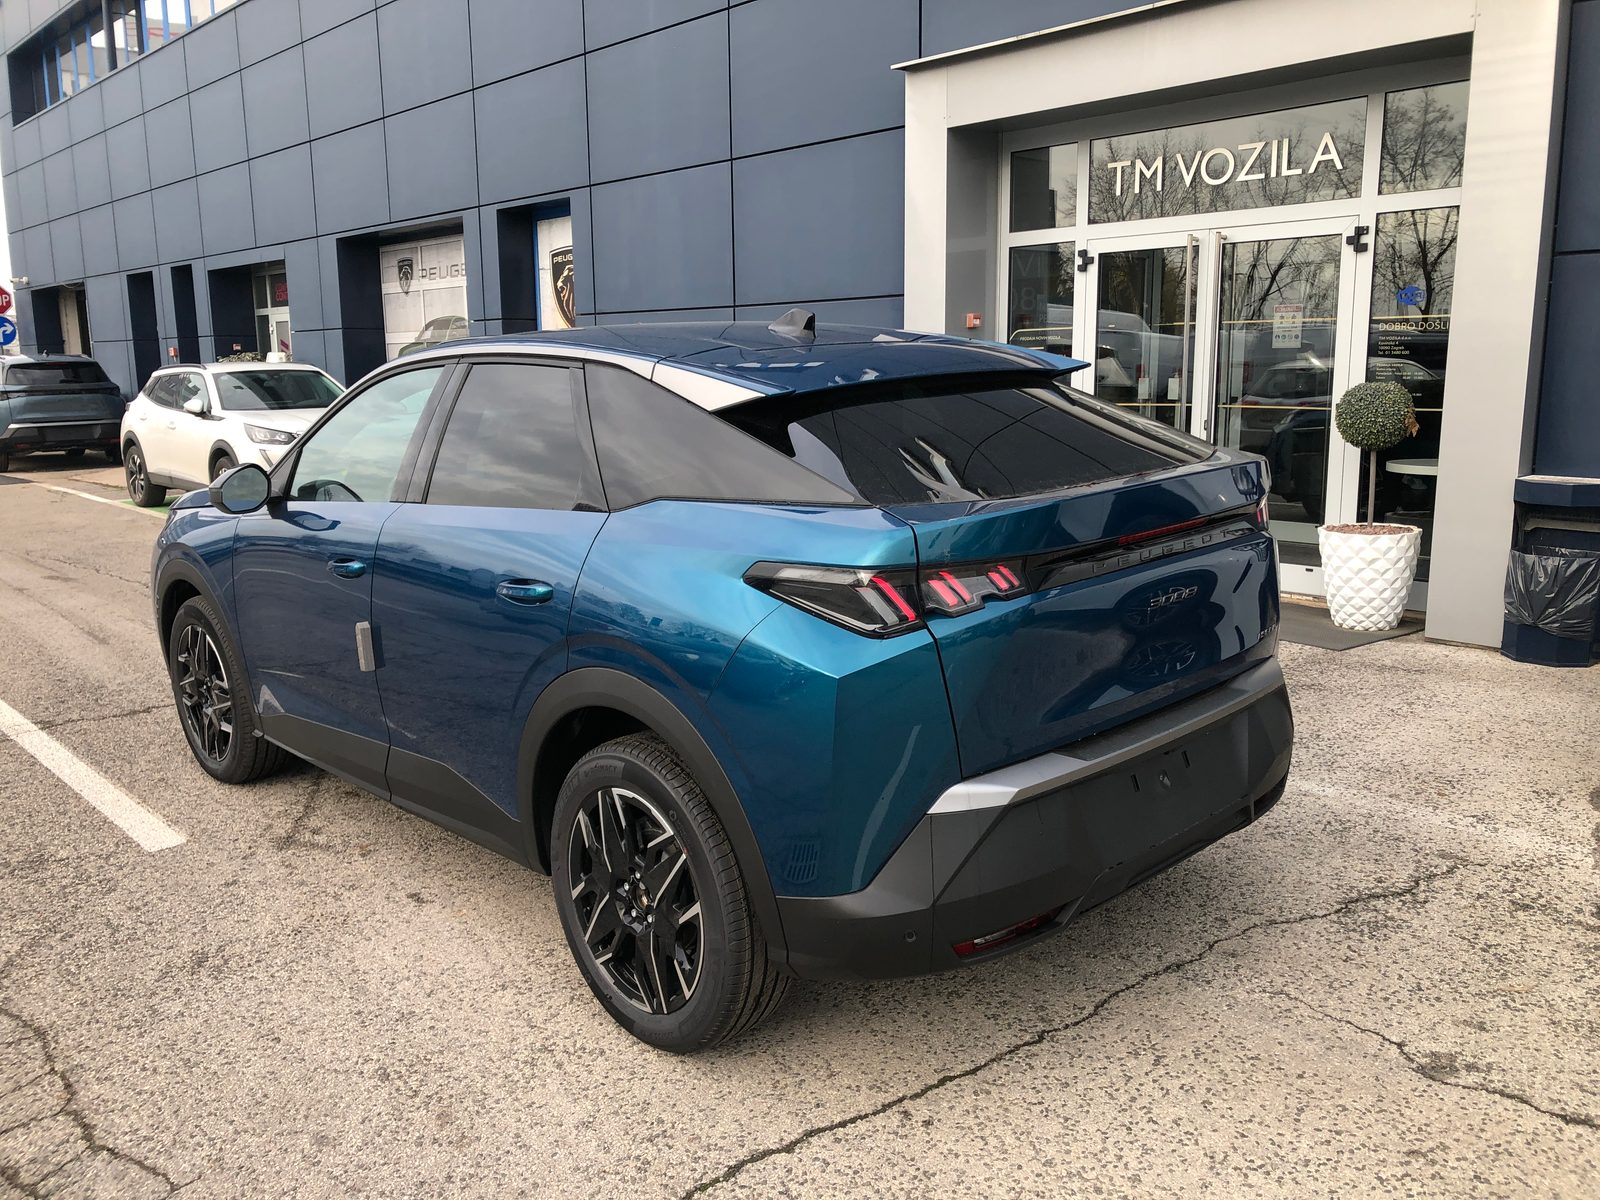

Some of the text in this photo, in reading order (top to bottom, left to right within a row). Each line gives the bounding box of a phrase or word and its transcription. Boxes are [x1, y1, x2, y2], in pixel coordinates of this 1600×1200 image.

[1107, 132, 1345, 197] TM VOZILA
[1379, 320, 1449, 331] DOBRO DOŠLI
[1091, 527, 1230, 575] PEUGEOT
[1150, 586, 1198, 609] 3008
